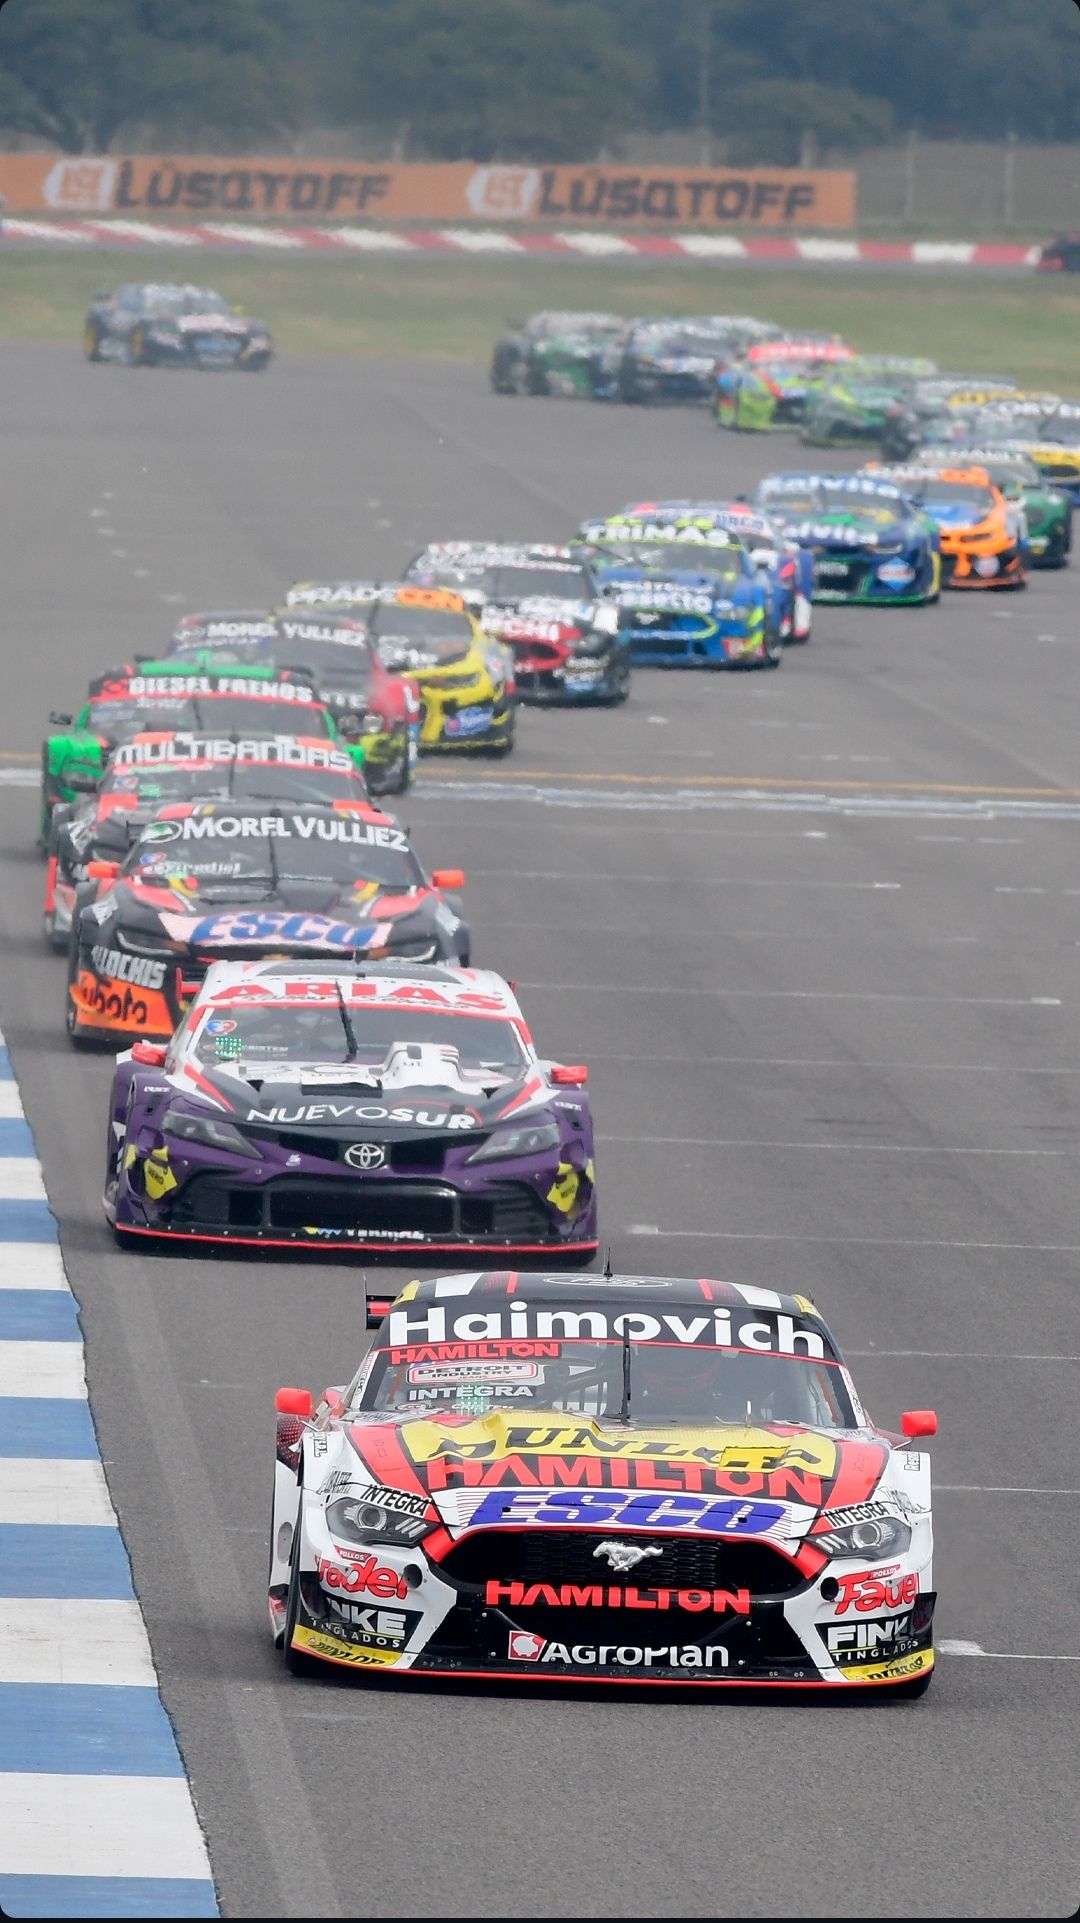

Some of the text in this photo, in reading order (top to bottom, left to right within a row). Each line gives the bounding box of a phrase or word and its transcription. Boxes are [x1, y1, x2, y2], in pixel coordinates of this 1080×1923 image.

[129, 677, 210, 695] DIESEL
[218, 679, 313, 702] FRENOS
[114, 739, 352, 772] MULTIBANDAS
[183, 816, 409, 852] MOREL VULLIEZ
[210, 982, 507, 1010] ARIAS
[246, 1104, 476, 1129] NUEVOSUR
[389, 1301, 824, 1359] Haimovich
[391, 1343, 559, 1364] HAMILTON
[418, 1365, 529, 1375] DETROIT
[432, 1370, 513, 1378] INDUSTRY
[409, 1386, 533, 1401] INTEGRA
[427, 1455, 822, 1505] HAMILTON
[361, 1484, 430, 1516] INTEGRA
[467, 1490, 787, 1533] ESCO
[823, 1501, 889, 1527] INTEGRA
[486, 1580, 750, 1614] HAMILTON
[827, 1616, 911, 1650] FINK
